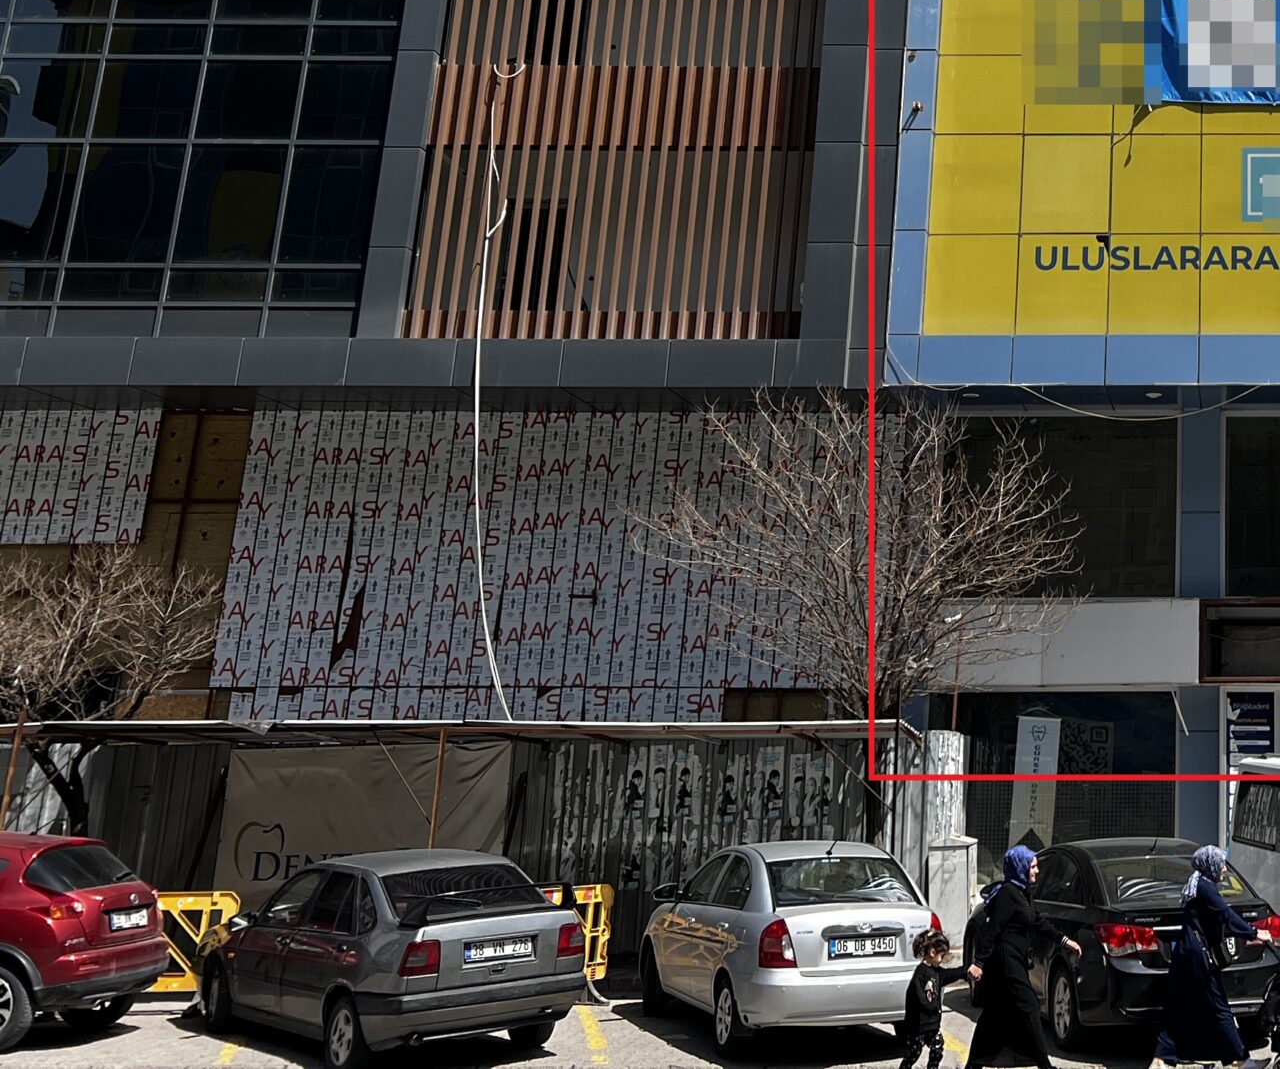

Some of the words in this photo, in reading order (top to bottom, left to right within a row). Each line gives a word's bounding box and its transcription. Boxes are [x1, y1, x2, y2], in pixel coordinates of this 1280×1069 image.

[472, 944, 484, 958] 38
[492, 941, 505, 955] VN
[836, 939, 848, 952] 06
[870, 937, 894, 951] 9450
